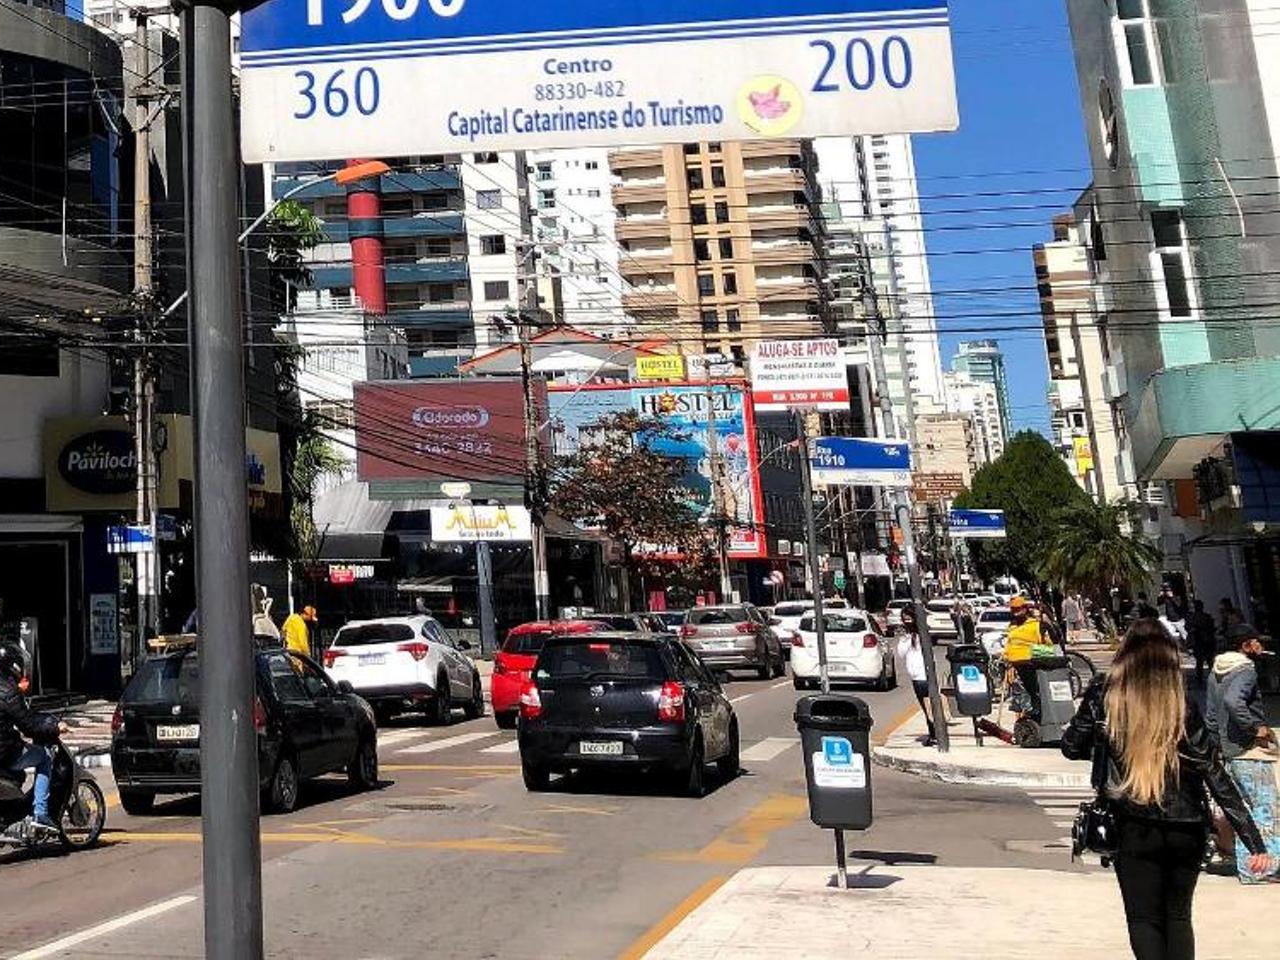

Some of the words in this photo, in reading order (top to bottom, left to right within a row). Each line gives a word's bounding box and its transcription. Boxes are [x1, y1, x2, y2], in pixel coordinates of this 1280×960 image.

[294, 66, 381, 121] 360
[544, 57, 613, 75] Centro
[809, 35, 914, 94] 200
[534, 80, 626, 101] 88330-482
[448, 107, 508, 142] Capital
[513, 105, 618, 134] Catarinense
[622, 101, 646, 128] do
[647, 99, 724, 127] Turismo
[818, 454, 846, 466] 1910
